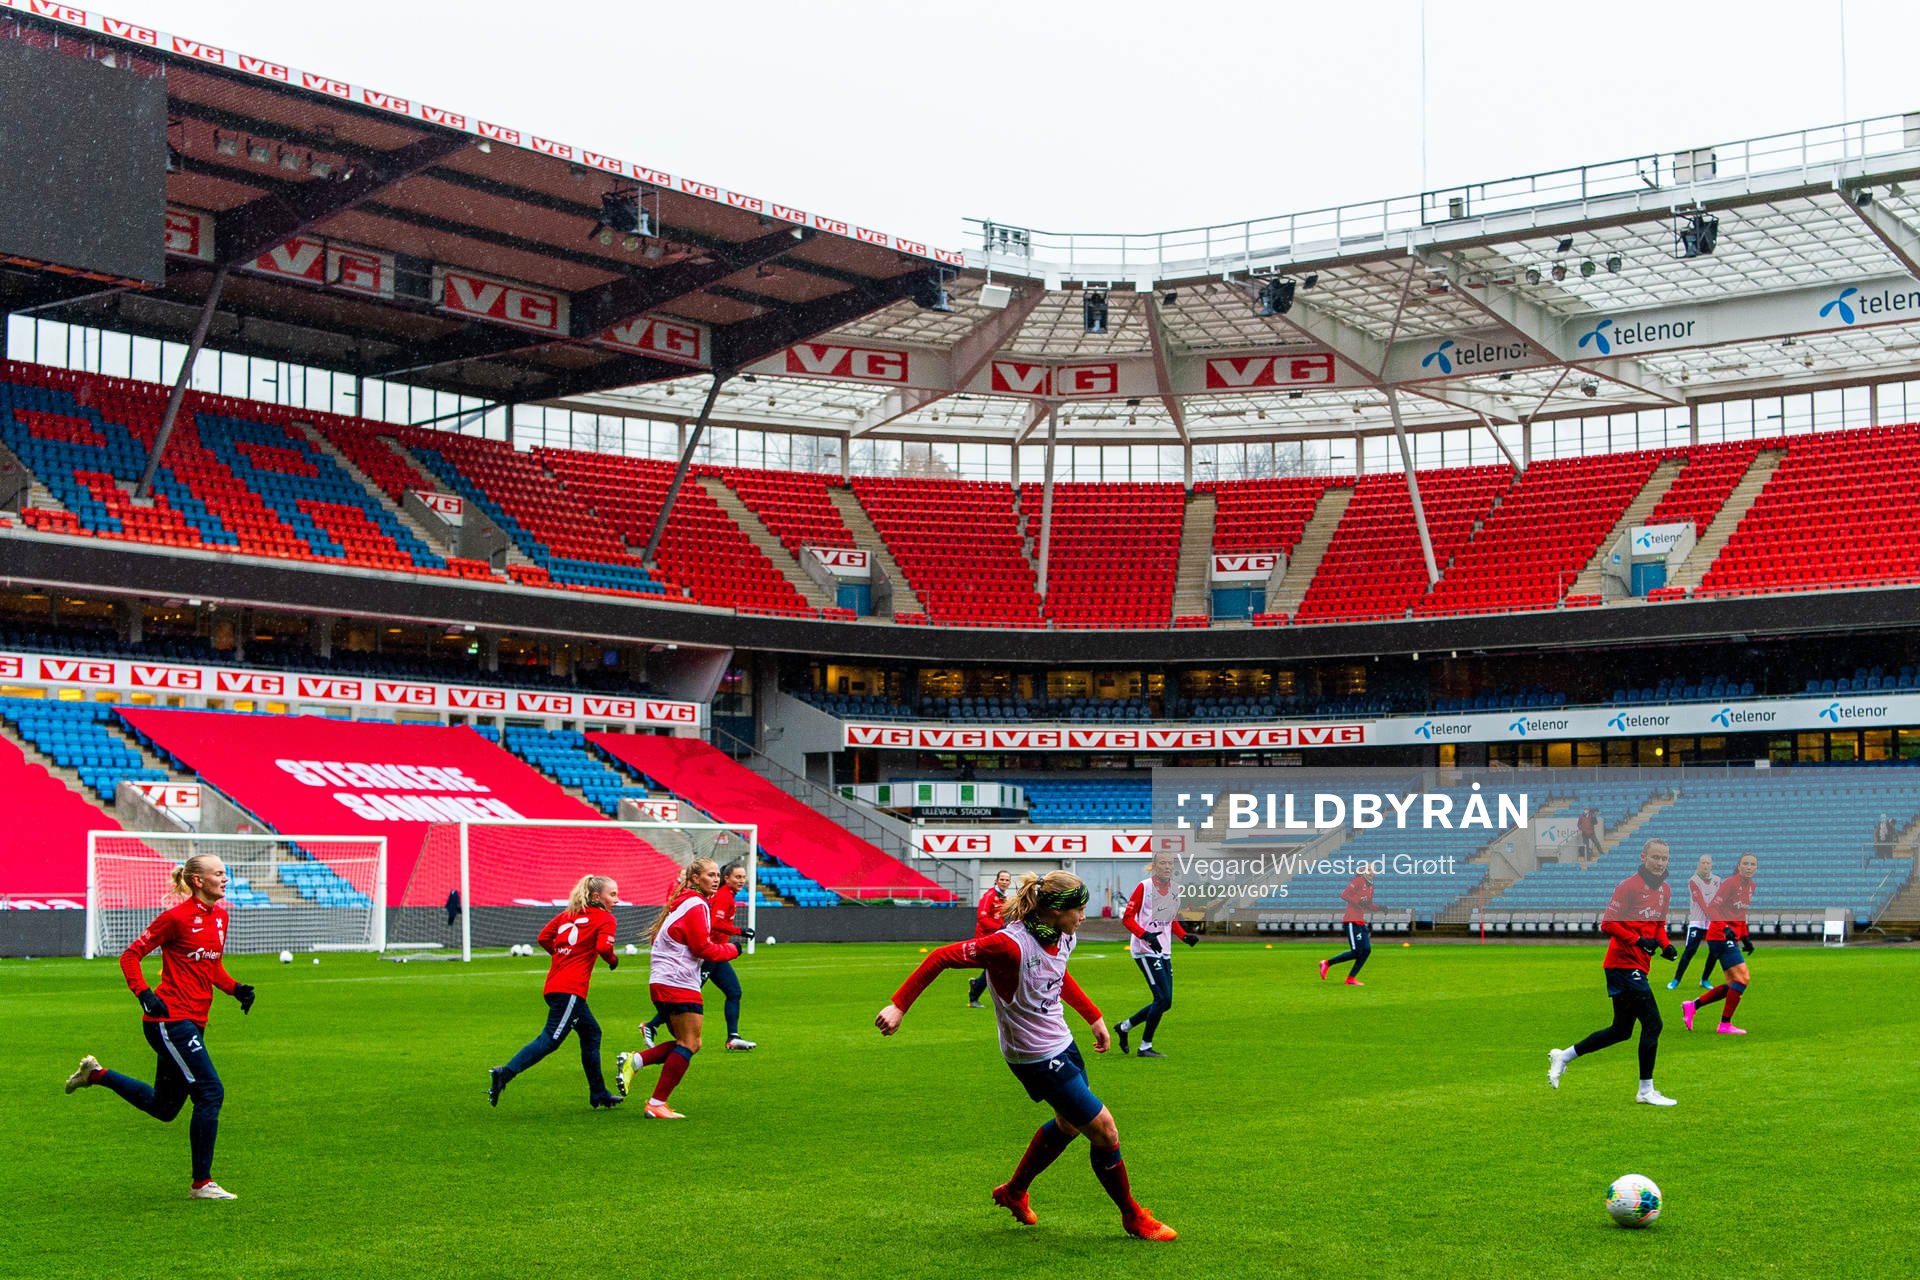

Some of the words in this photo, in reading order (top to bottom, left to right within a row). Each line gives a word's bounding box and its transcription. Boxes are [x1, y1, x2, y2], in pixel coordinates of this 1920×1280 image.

[32, 0, 83, 24] VG
[106, 18, 155, 45] VG
[175, 38, 223, 62] VG
[242, 56, 287, 79] VG
[304, 74, 349, 96] VG
[365, 91, 407, 112] VG
[424, 107, 464, 128] VG
[479, 123, 519, 143] VG
[533, 138, 571, 157] VG
[585, 152, 621, 171] VG
[635, 167, 669, 185] VG
[683, 180, 716, 198] VG
[729, 193, 761, 211] VG
[774, 206, 805, 223] VG
[817, 218, 846, 234] VG
[857, 229, 886, 245] VG
[897, 240, 925, 255] VG
[936, 249, 963, 265] VG
[450, 277, 552, 327] VG
[1859, 289, 1920, 314] telen
[613, 318, 696, 357] VG
[1614, 320, 1696, 345] telenor
[792, 344, 902, 381] VG
[1456, 343, 1528, 365] telenor
[996, 362, 1112, 393] VG
[1210, 355, 1330, 386] VG
[1651, 533, 1682, 544] telen
[811, 550, 864, 567] VG
[1218, 556, 1274, 571] VG
[43, 662, 113, 682] VG
[132, 667, 200, 688] VG
[218, 674, 281, 694] VG
[301, 680, 360, 699] VG
[377, 685, 434, 703] VG
[450, 690, 504, 708] VG
[519, 695, 570, 712] VG
[585, 700, 633, 716] VG
[648, 704, 693, 720] VG
[1431, 723, 1472, 735] telenor
[1527, 719, 1568, 731] telenor
[1626, 714, 1670, 727] telenor
[1730, 710, 1776, 723] telenor
[1840, 705, 1887, 718] telenor
[850, 729, 910, 744] VG
[922, 731, 983, 746] VG
[995, 732, 1058, 747] VG
[1072, 732, 1136, 747] VG
[1148, 732, 1212, 747] VG
[1225, 730, 1289, 745] VG
[1301, 727, 1361, 744] VG
[275, 759, 491, 792] STERKERE
[333, 793, 526, 822] SAMMEN
[922, 808, 957, 816] ULLEVAAL
[961, 808, 991, 816] STADION
[926, 836, 987, 852] VG
[1017, 836, 1084, 852] VG
[1114, 836, 1182, 852] VG
